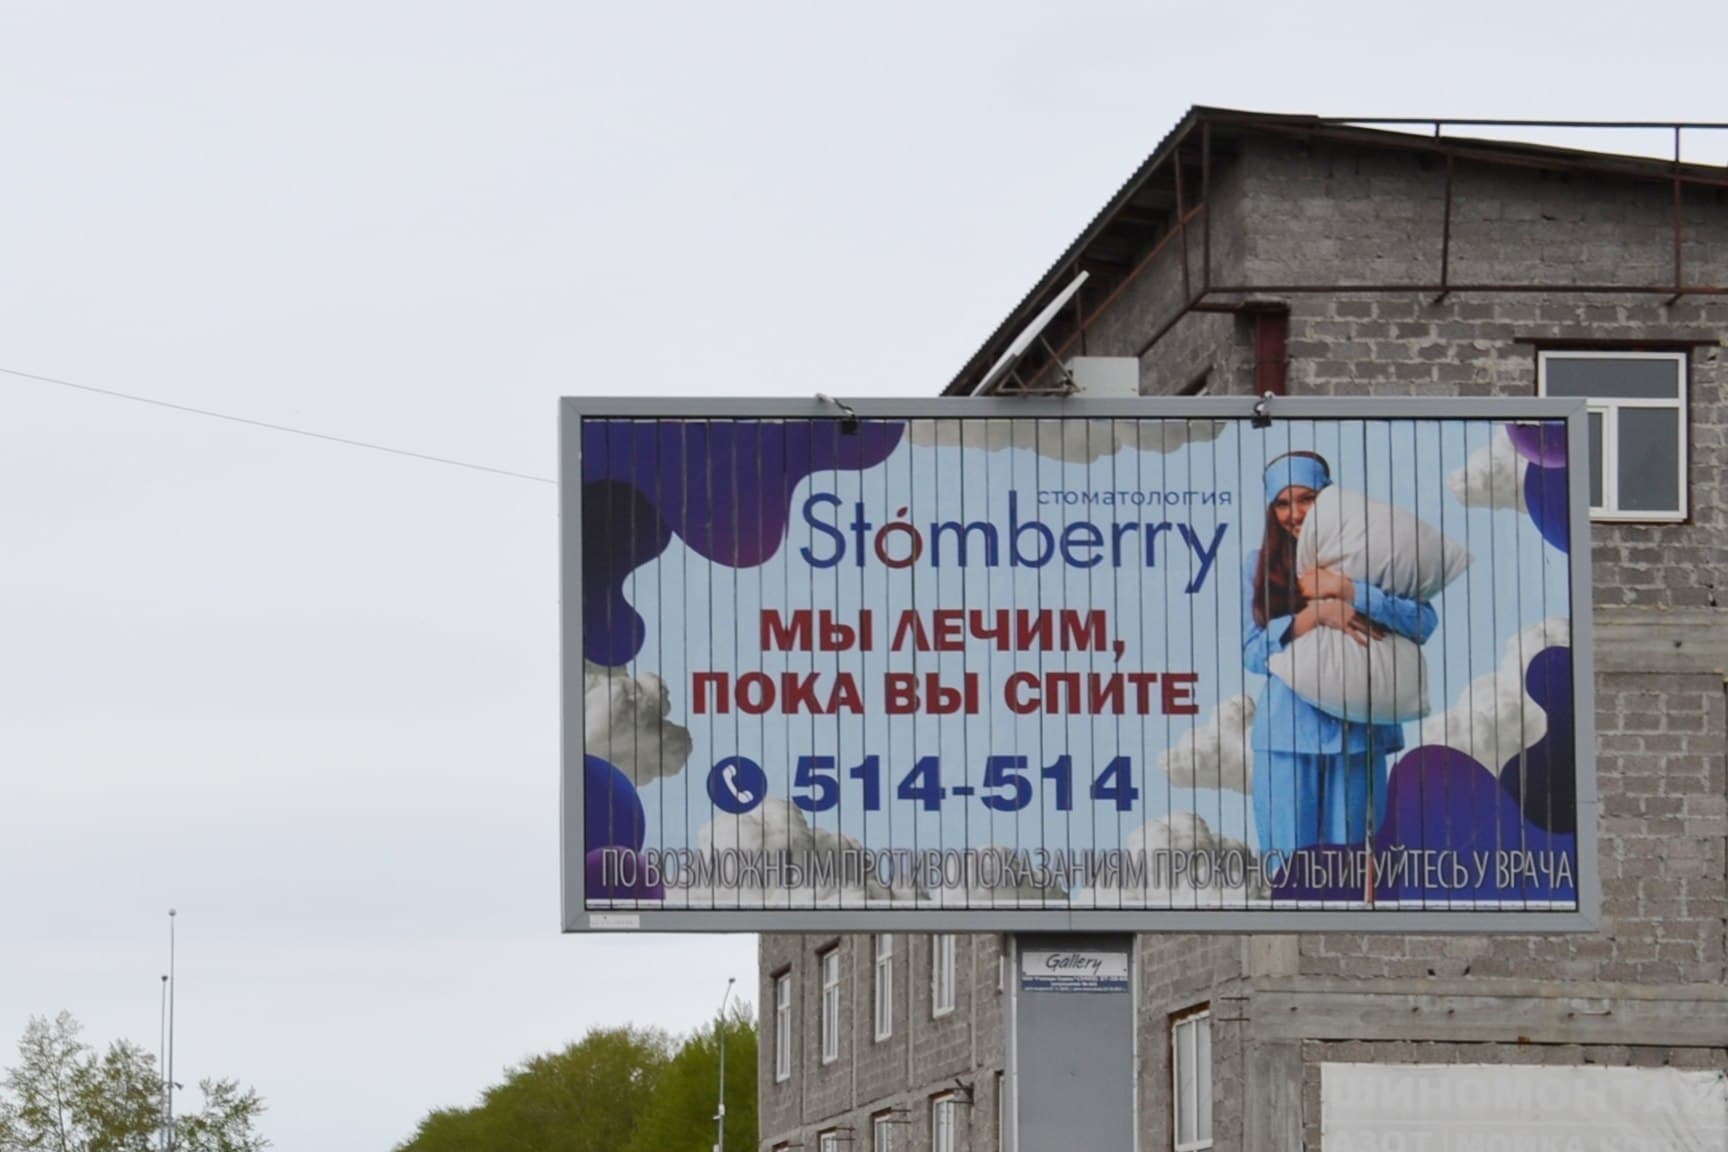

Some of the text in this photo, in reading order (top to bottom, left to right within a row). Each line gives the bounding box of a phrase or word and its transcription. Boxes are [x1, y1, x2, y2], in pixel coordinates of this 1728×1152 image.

[1037, 490, 1232, 506] стоматология
[760, 608, 1125, 662] МЫ ЛЕЧИМ,
[692, 671, 1200, 715] ПОКА ВЫ СПИТЕ
[792, 754, 1139, 812] 514-514
[601, 845, 1574, 889] ПО ВОЗМОЖНЫМ ПРОТИВОПОКАЗАНИЯМ ПРОКОНСУЛЬТИРУЙТЕСЬ У ВРАЧА
[1045, 953, 1103, 975] Gallery
